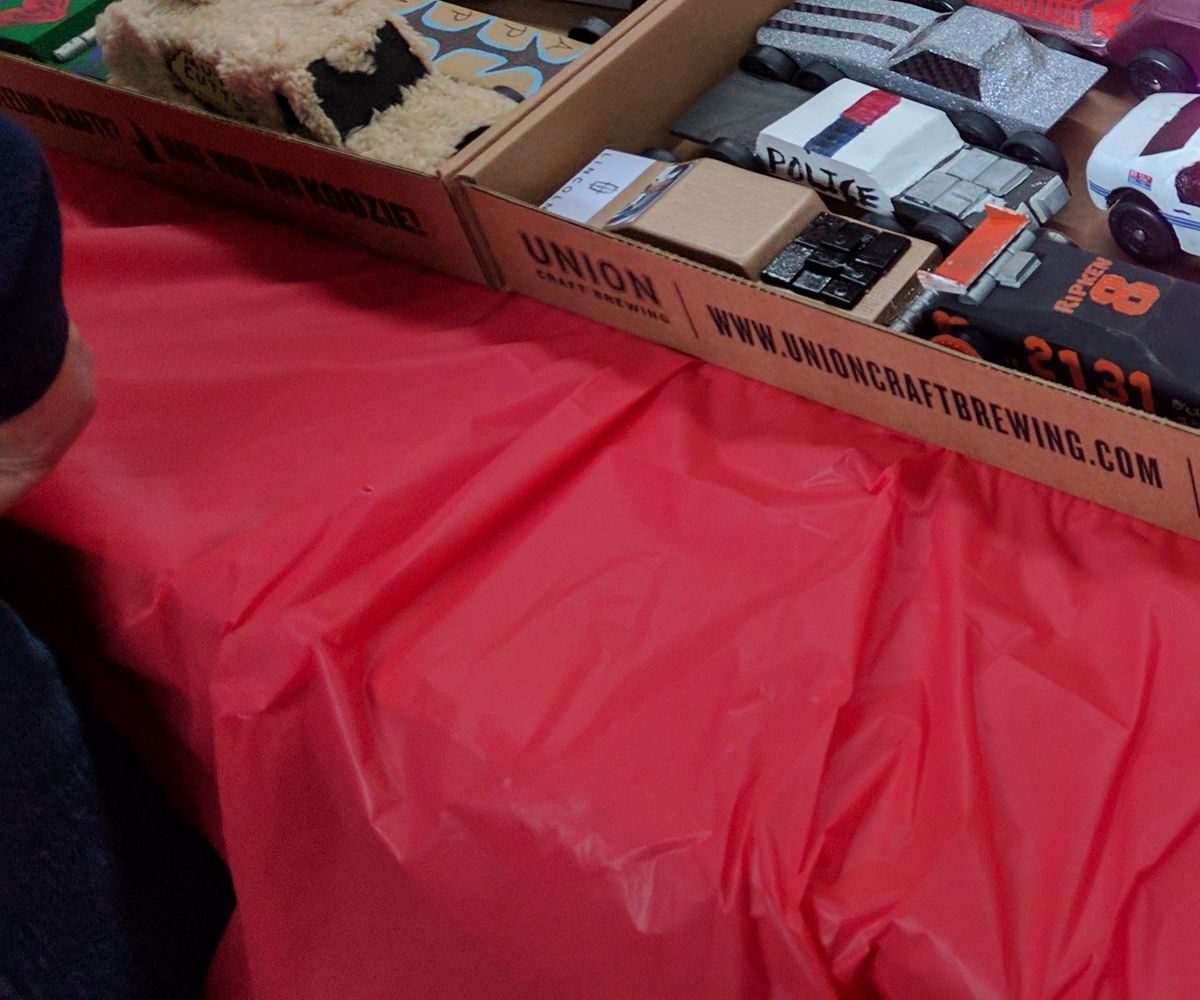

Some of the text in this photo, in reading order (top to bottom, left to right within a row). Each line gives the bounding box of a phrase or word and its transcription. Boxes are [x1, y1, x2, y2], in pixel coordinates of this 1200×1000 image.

[299, 176, 428, 235] KOOZIE!
[766, 147, 881, 209] POLICE
[519, 232, 661, 304] UNION
[536, 269, 670, 323] CRAFT BREWING
[1053, 256, 1113, 315] RIPKEN
[1090, 274, 1161, 317] 8
[706, 303, 1164, 490] WWW.UNIONCRAFTBREWING.COM
[1024, 335, 1156, 414] 2131
